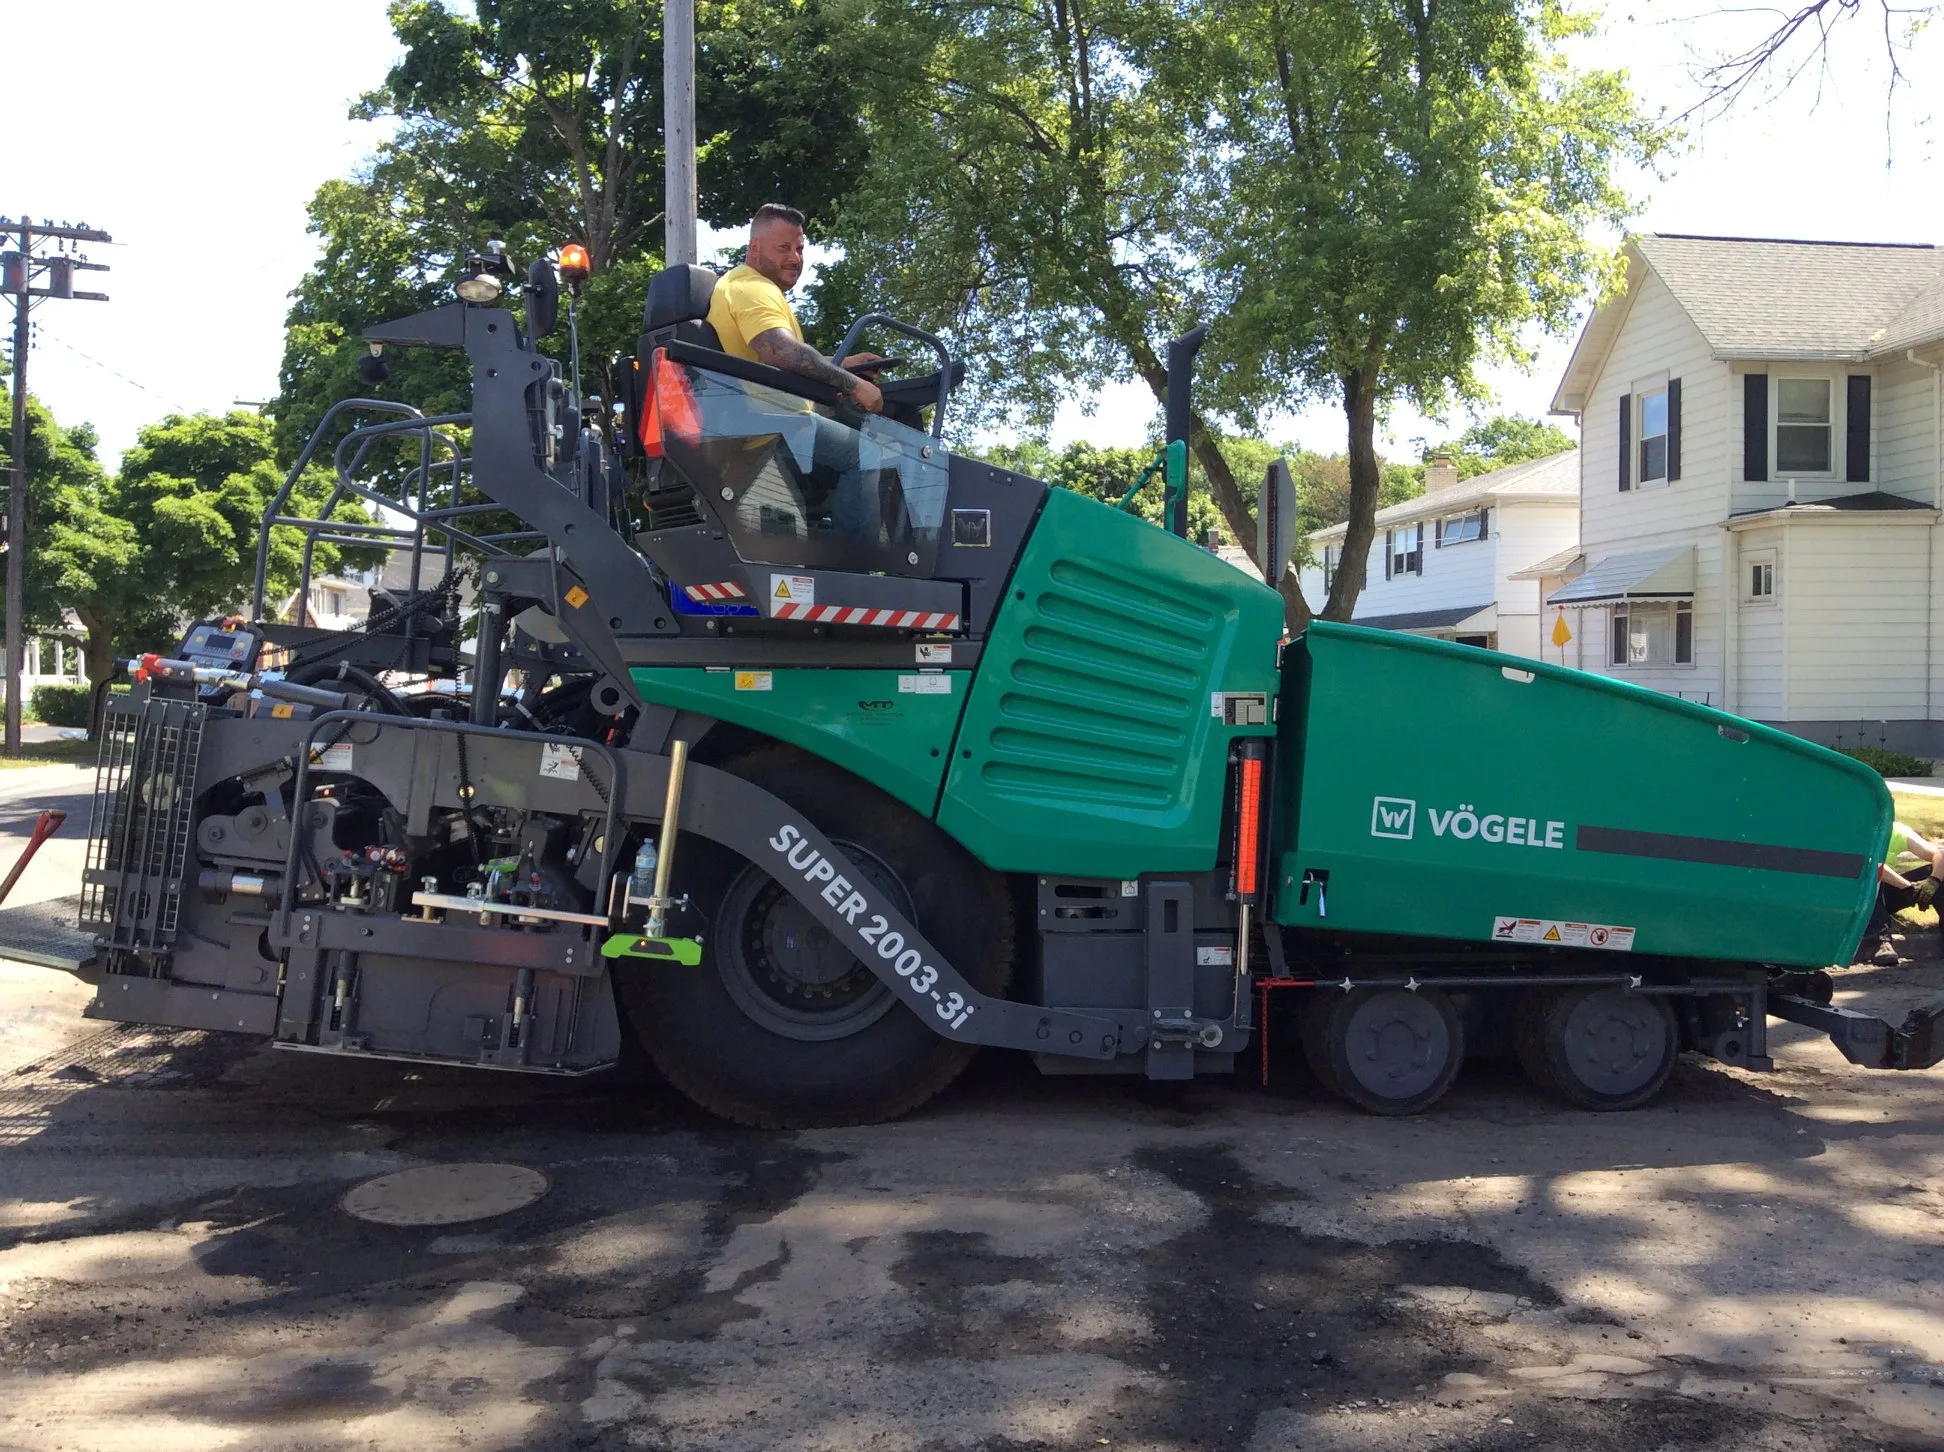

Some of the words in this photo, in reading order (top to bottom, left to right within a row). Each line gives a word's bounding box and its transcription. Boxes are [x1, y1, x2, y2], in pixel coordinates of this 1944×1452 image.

[1428, 803, 1565, 849] VÖGELE
[769, 824, 868, 925] SUPER
[858, 914, 974, 1030] 2003-3i
